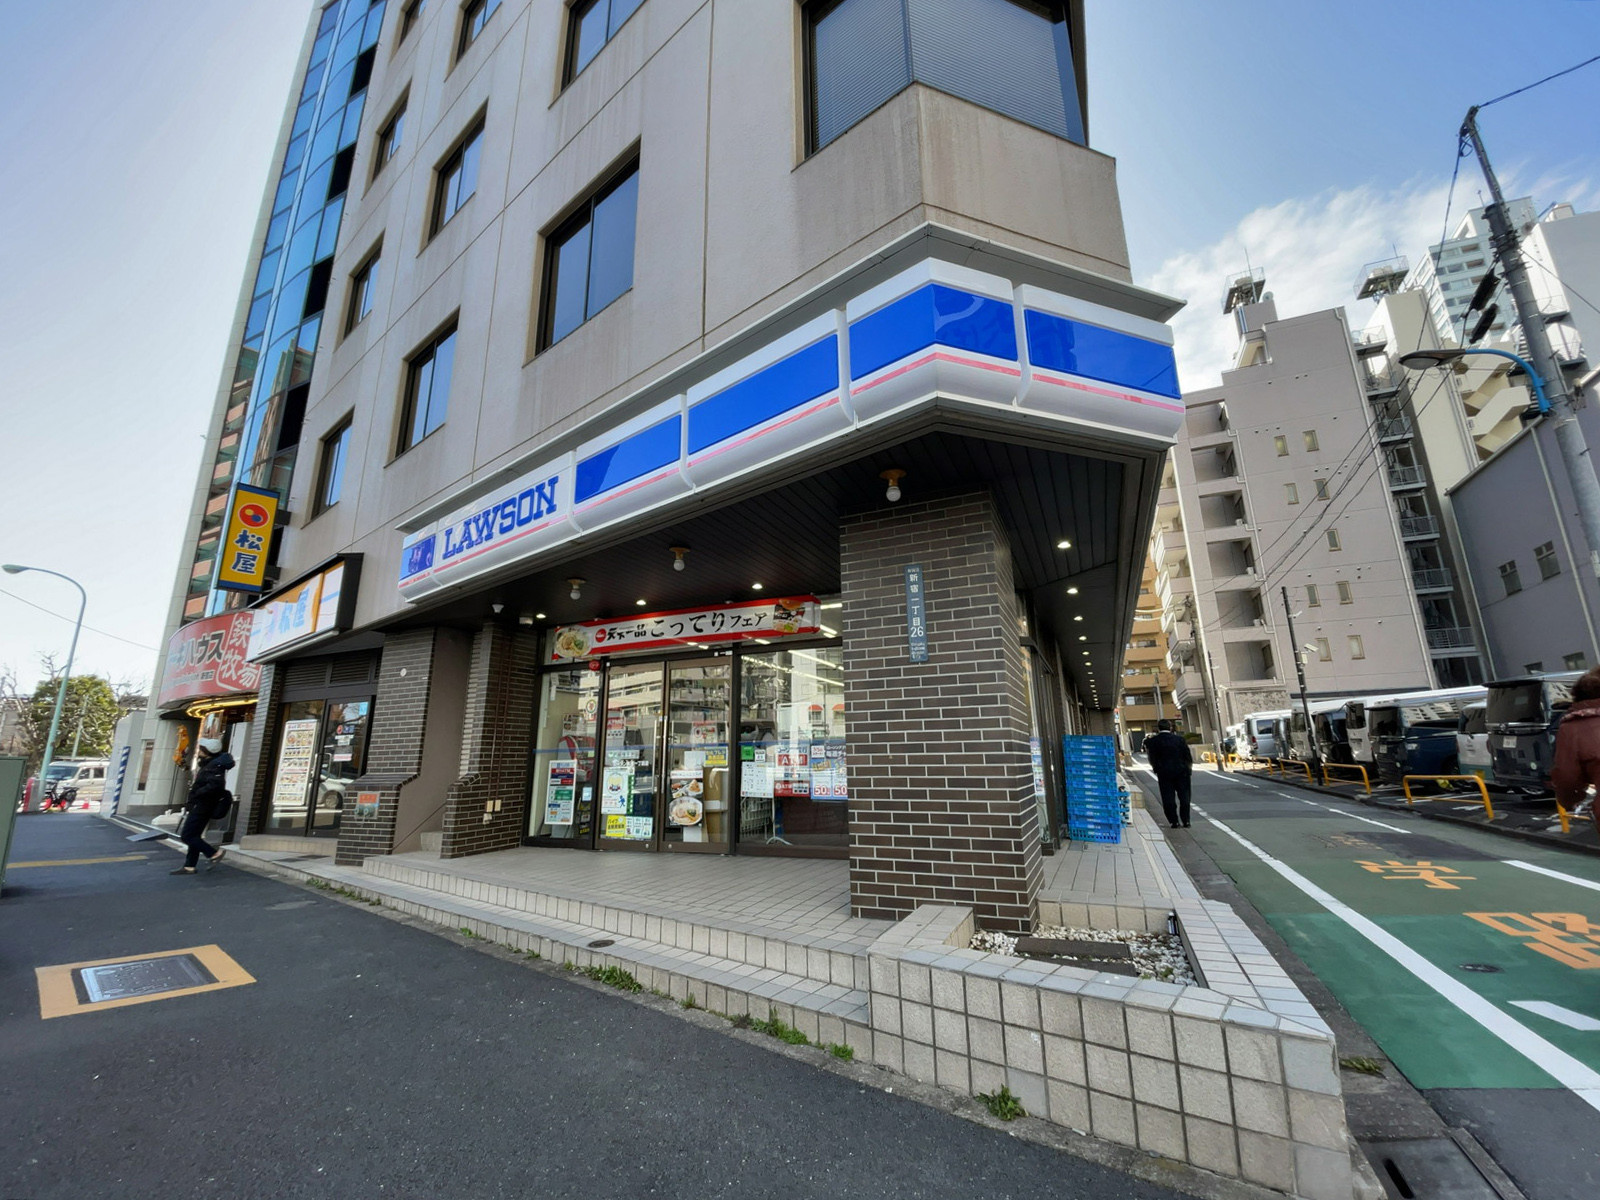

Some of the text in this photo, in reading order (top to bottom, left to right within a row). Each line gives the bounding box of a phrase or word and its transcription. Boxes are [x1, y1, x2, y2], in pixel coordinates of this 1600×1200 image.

[442, 475, 559, 560] LAWSON
[231, 528, 263, 575] 松屋
[606, 623, 648, 641] 天下一品
